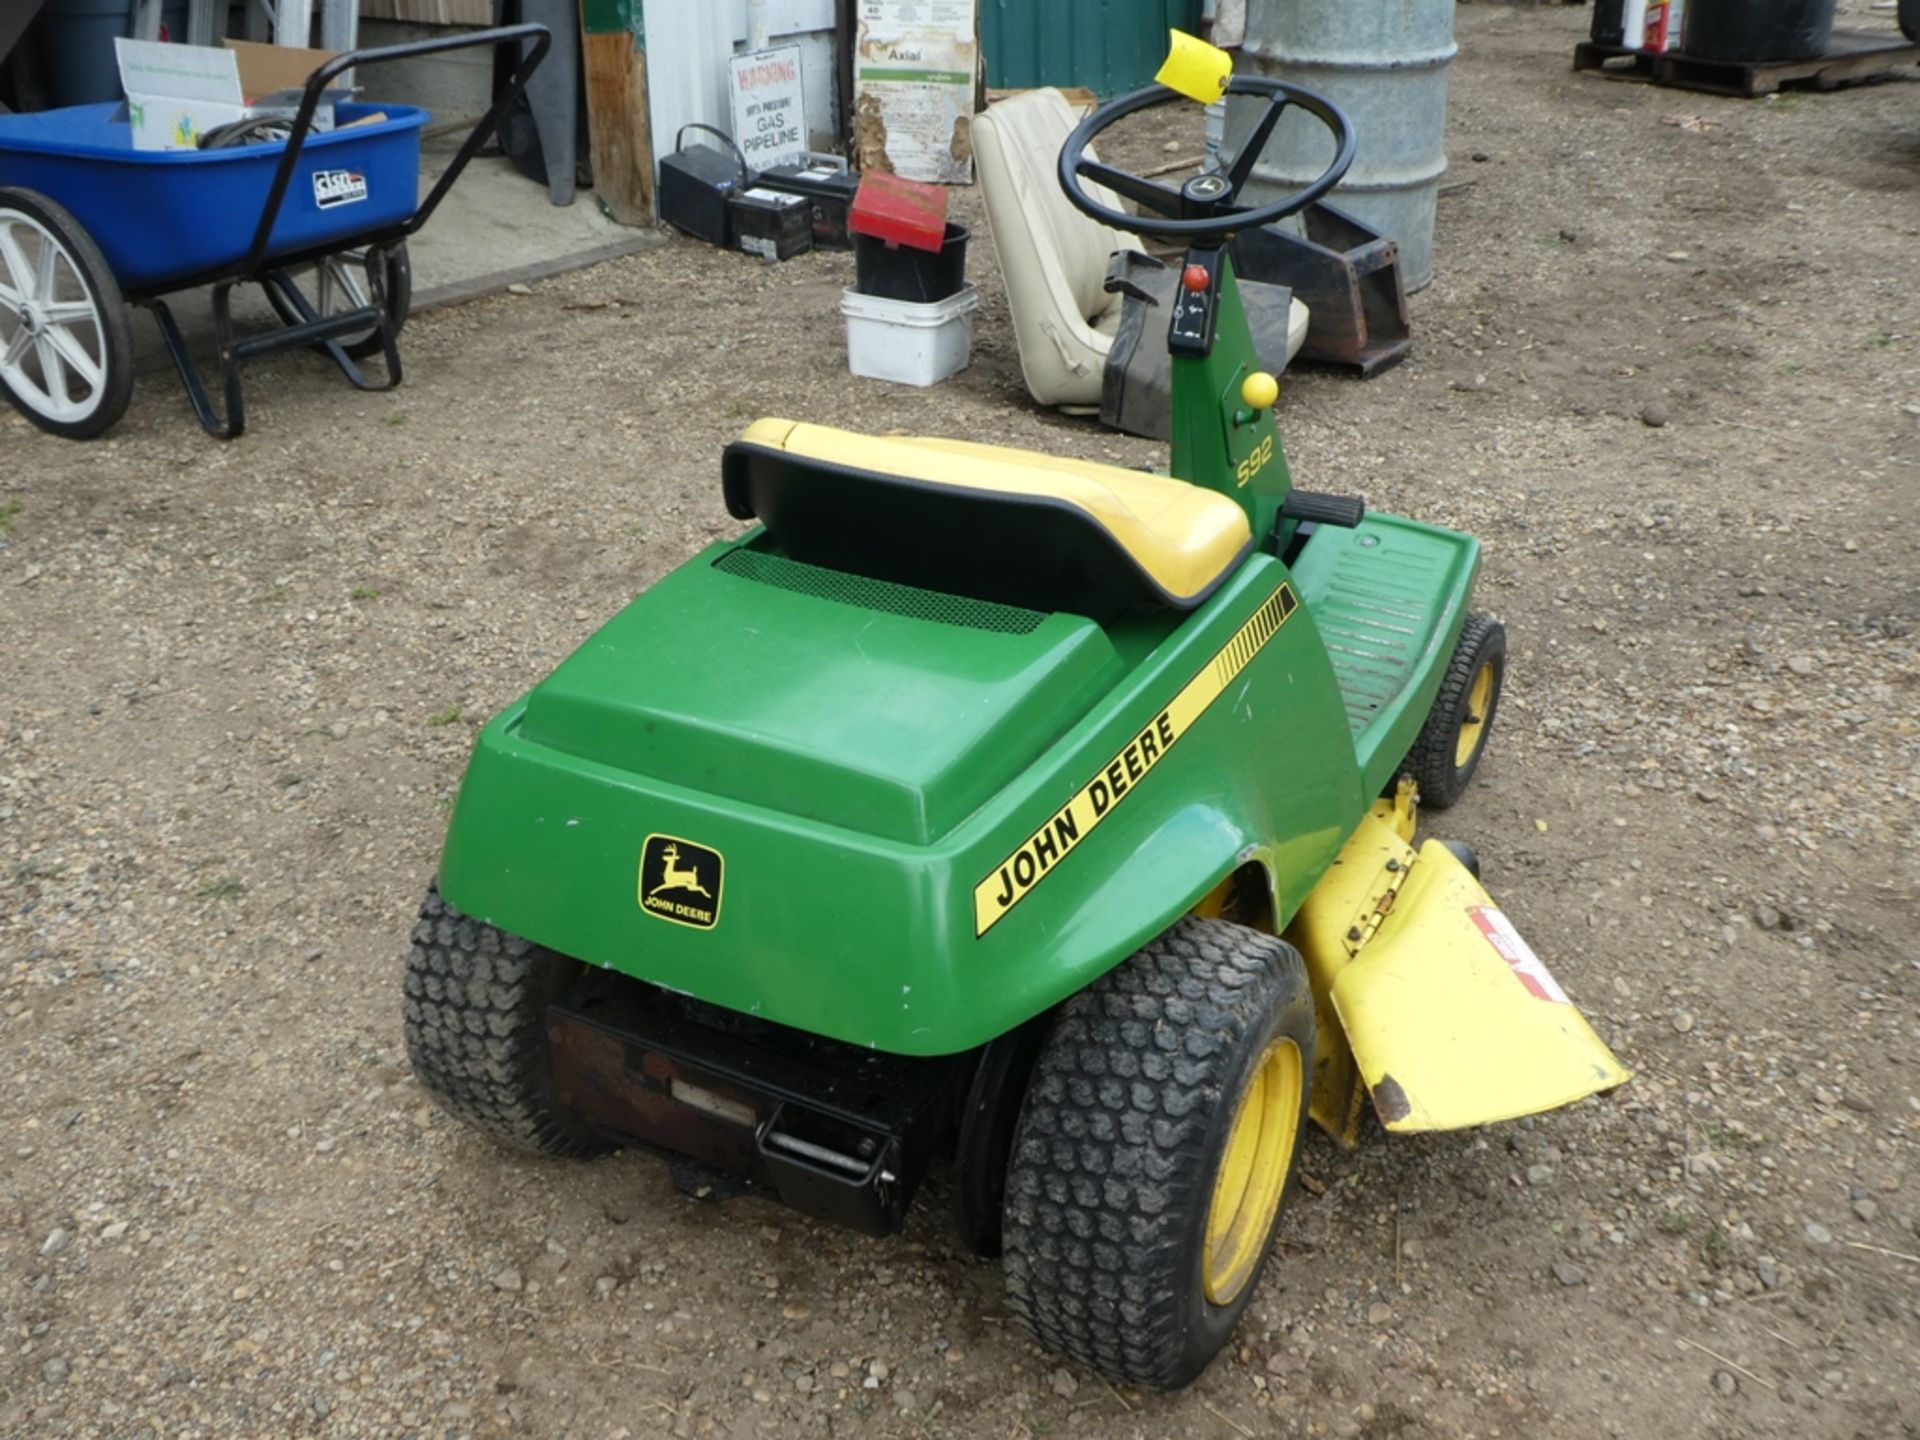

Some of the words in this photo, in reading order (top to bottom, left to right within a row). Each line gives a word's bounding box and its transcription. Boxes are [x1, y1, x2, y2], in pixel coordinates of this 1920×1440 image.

[888, 48, 922, 61] Axial
[757, 113, 784, 132] GAS
[744, 127, 799, 154] PIPELINE
[1237, 435, 1272, 489] S92
[996, 807, 1080, 908] JOHN
[1088, 710, 1175, 818] DEERE
[645, 895, 674, 912] JOHN
[675, 903, 712, 923] DEERE
